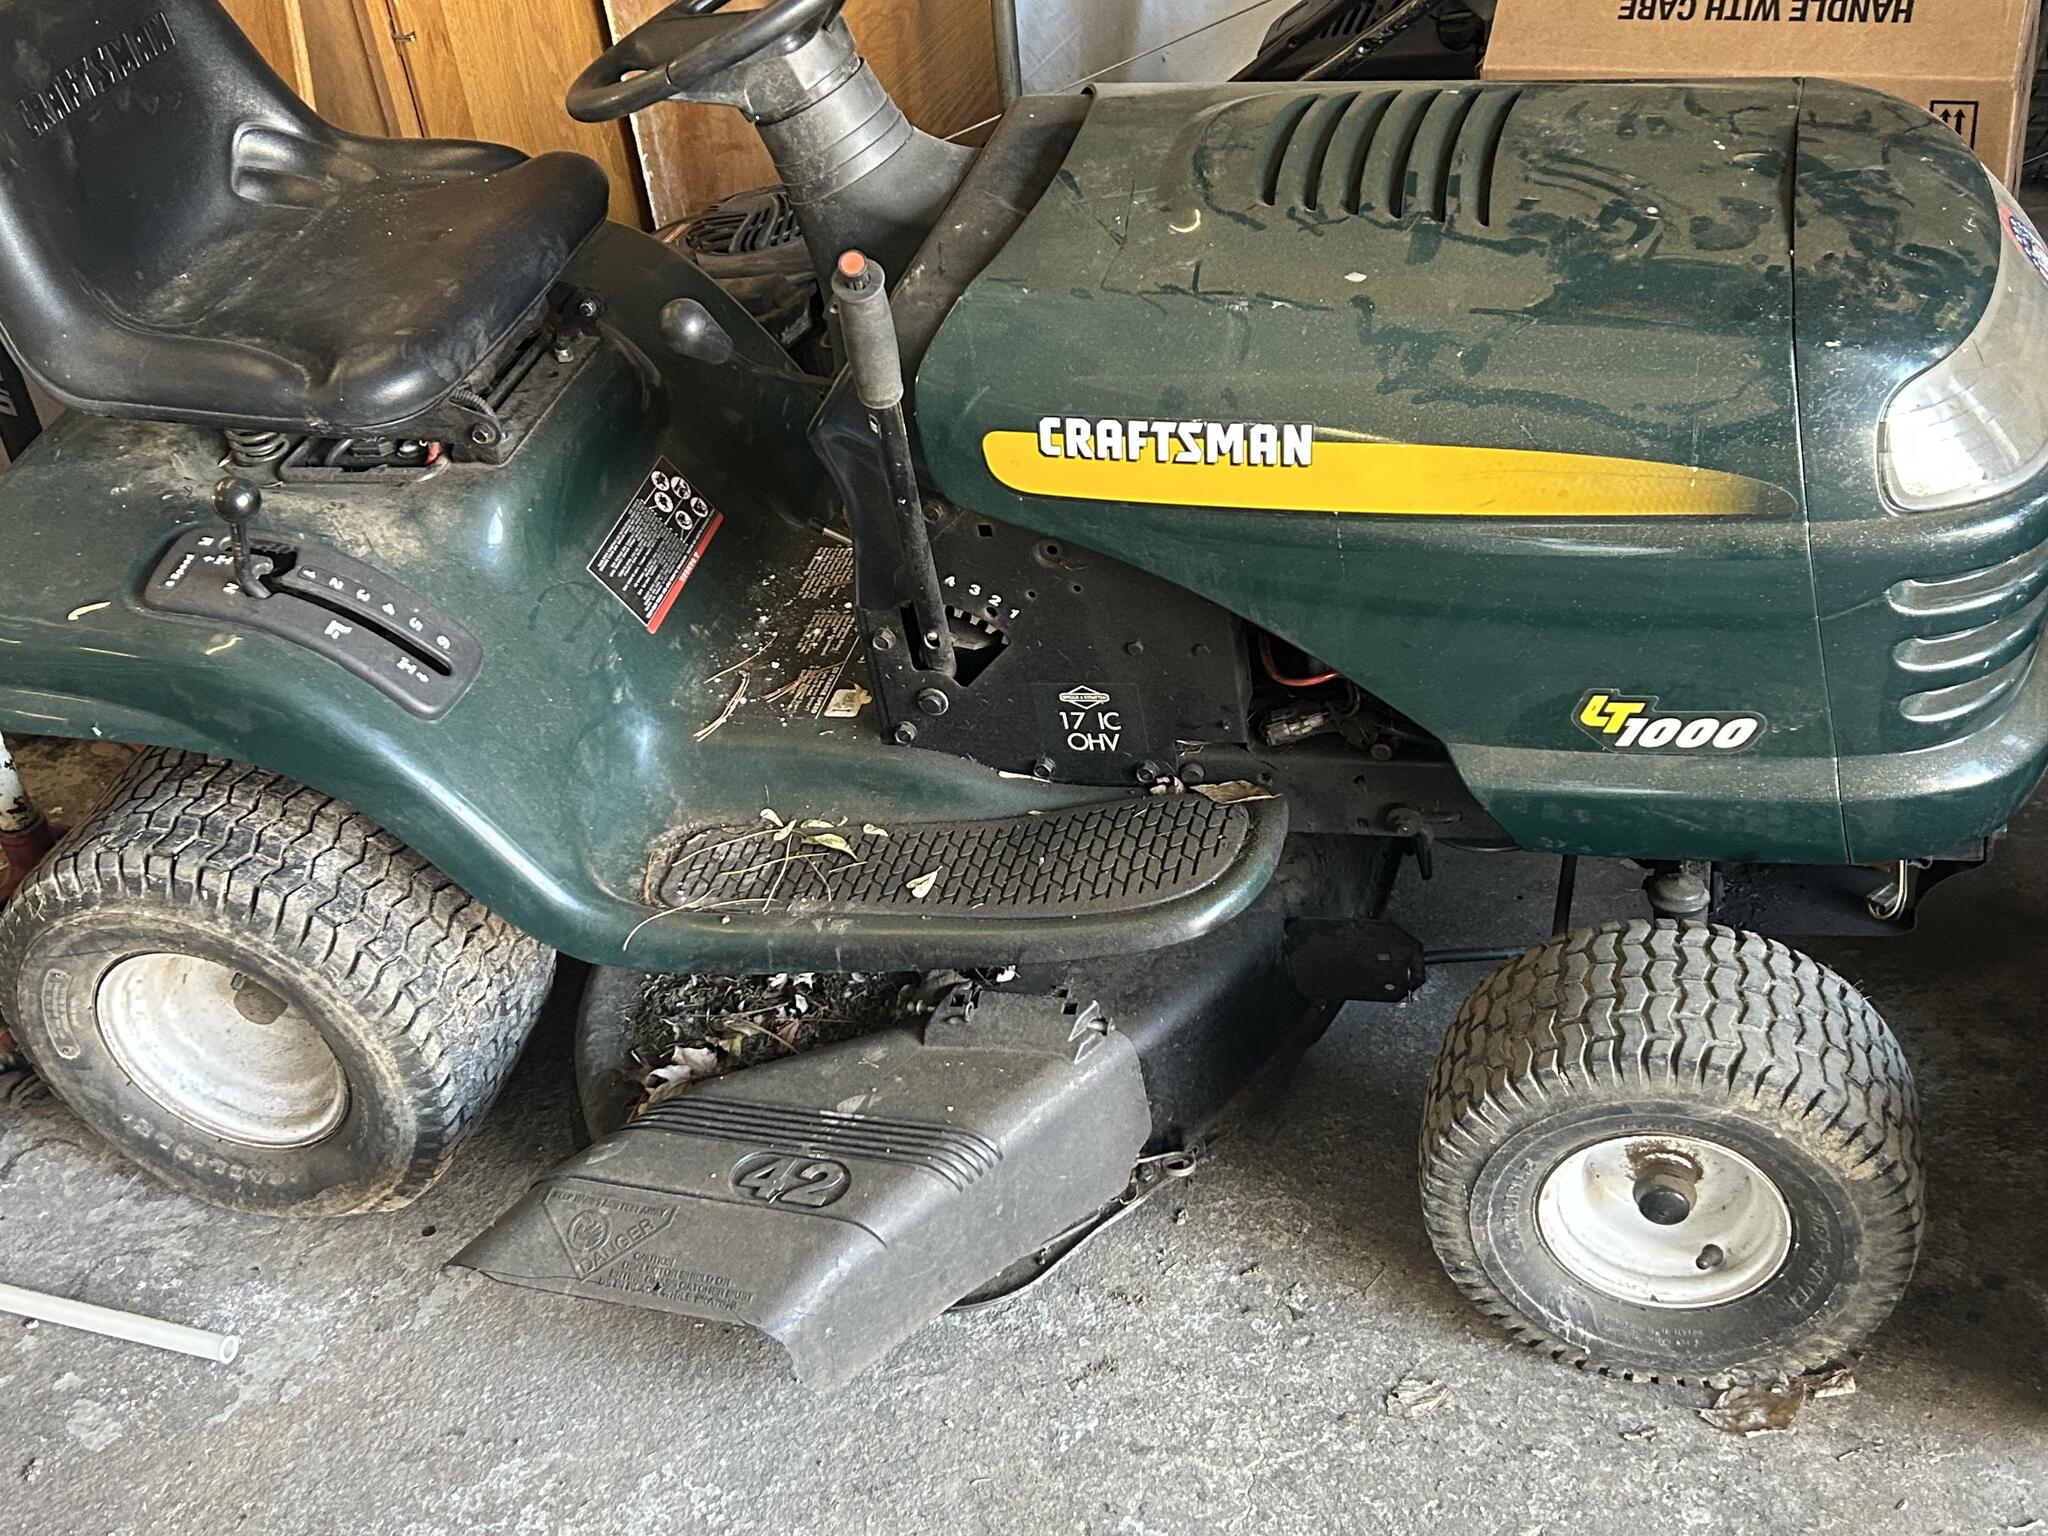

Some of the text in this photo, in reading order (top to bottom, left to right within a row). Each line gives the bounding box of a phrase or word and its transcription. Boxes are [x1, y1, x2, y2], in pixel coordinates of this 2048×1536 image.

[1617, 0, 1912, 22] HANDLE WITH CARE
[17, 11, 176, 137] CRAFTSMAN
[1038, 416, 1313, 467] CRAFTSMAN
[328, 577, 344, 590] 2
[356, 588, 371, 602] 3
[409, 617, 424, 632] 5
[943, 575, 1020, 619] 4 3 2 1
[1059, 711, 1086, 730] 17
[1067, 732, 1120, 752] OHV
[738, 1157, 844, 1206] 42
[579, 1218, 656, 1275] DANGER
